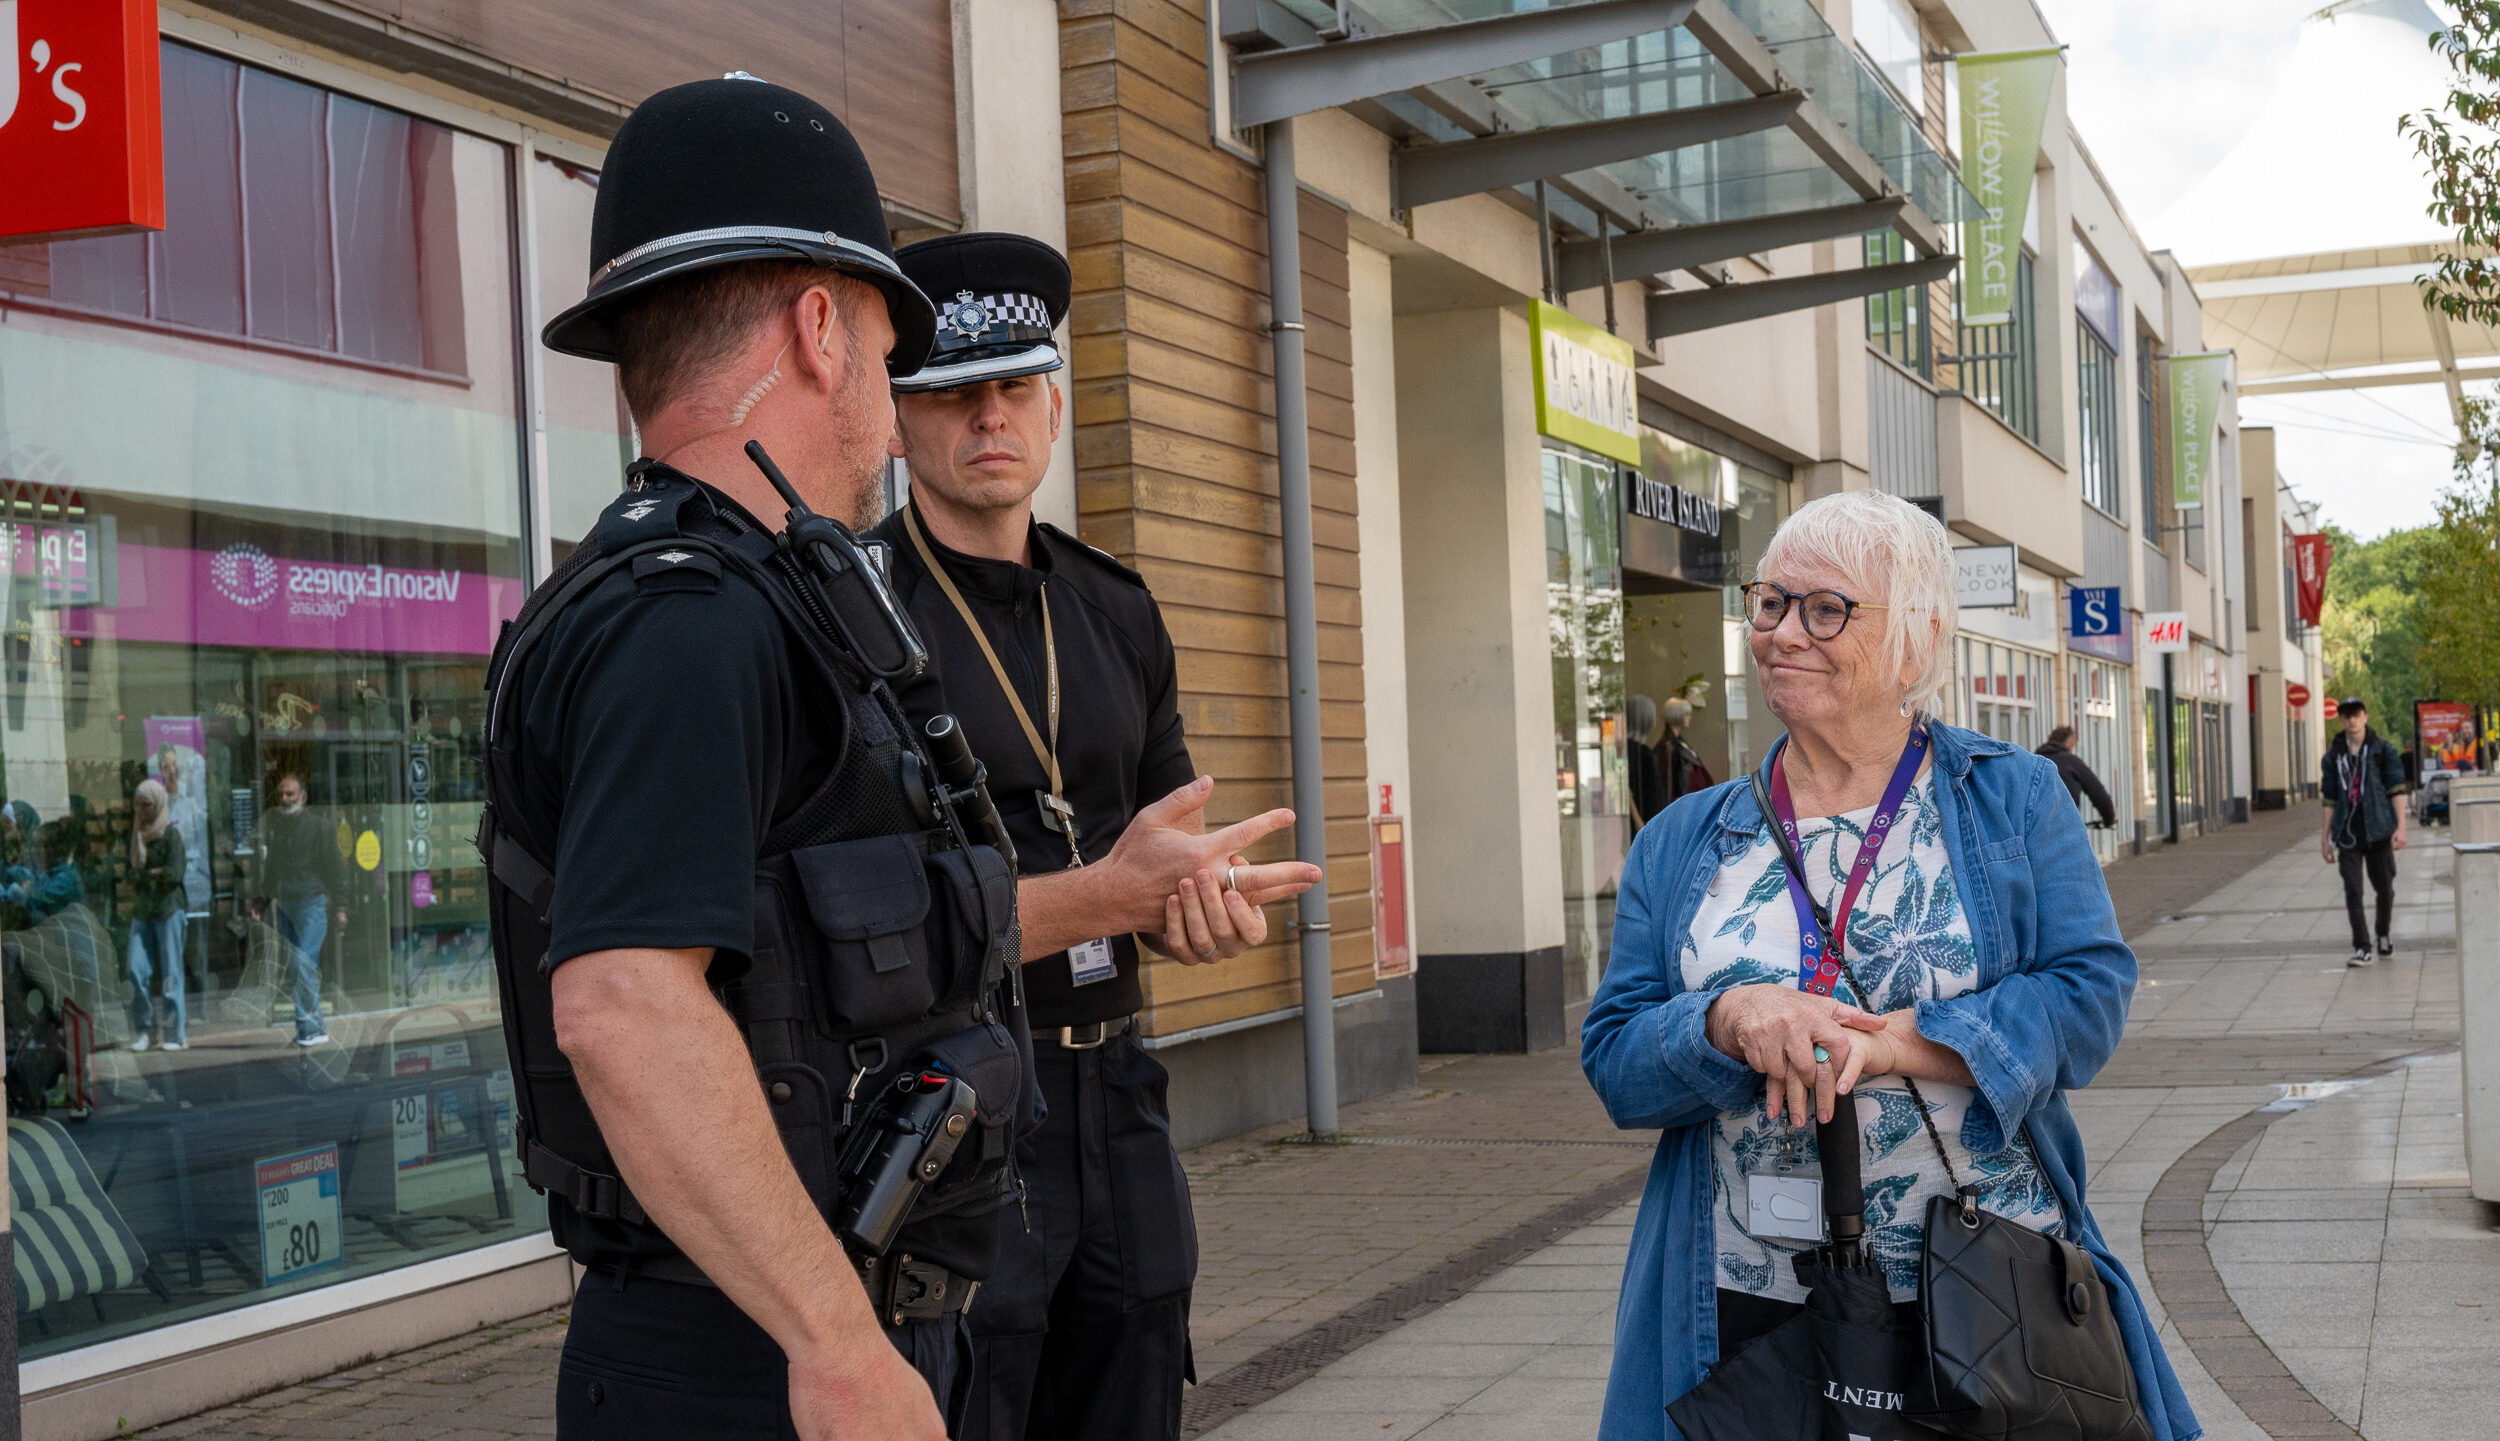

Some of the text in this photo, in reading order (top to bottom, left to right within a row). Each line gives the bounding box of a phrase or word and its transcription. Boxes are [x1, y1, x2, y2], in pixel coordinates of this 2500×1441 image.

[1976, 77, 2010, 298] WILLOW PLACE
[2181, 368, 2200, 495] WILLOW PLACE
[1635, 470, 1720, 537] RIVER ISLAND
[1957, 578, 2014, 593] LOOK
[1958, 563, 2009, 578] NEW
[2084, 600, 2109, 635] S
[2148, 620, 2184, 644] H&M
[290, 1158, 313, 1176] GREAT
[313, 1151, 335, 1172] DEAL
[282, 1219, 320, 1271] £80
